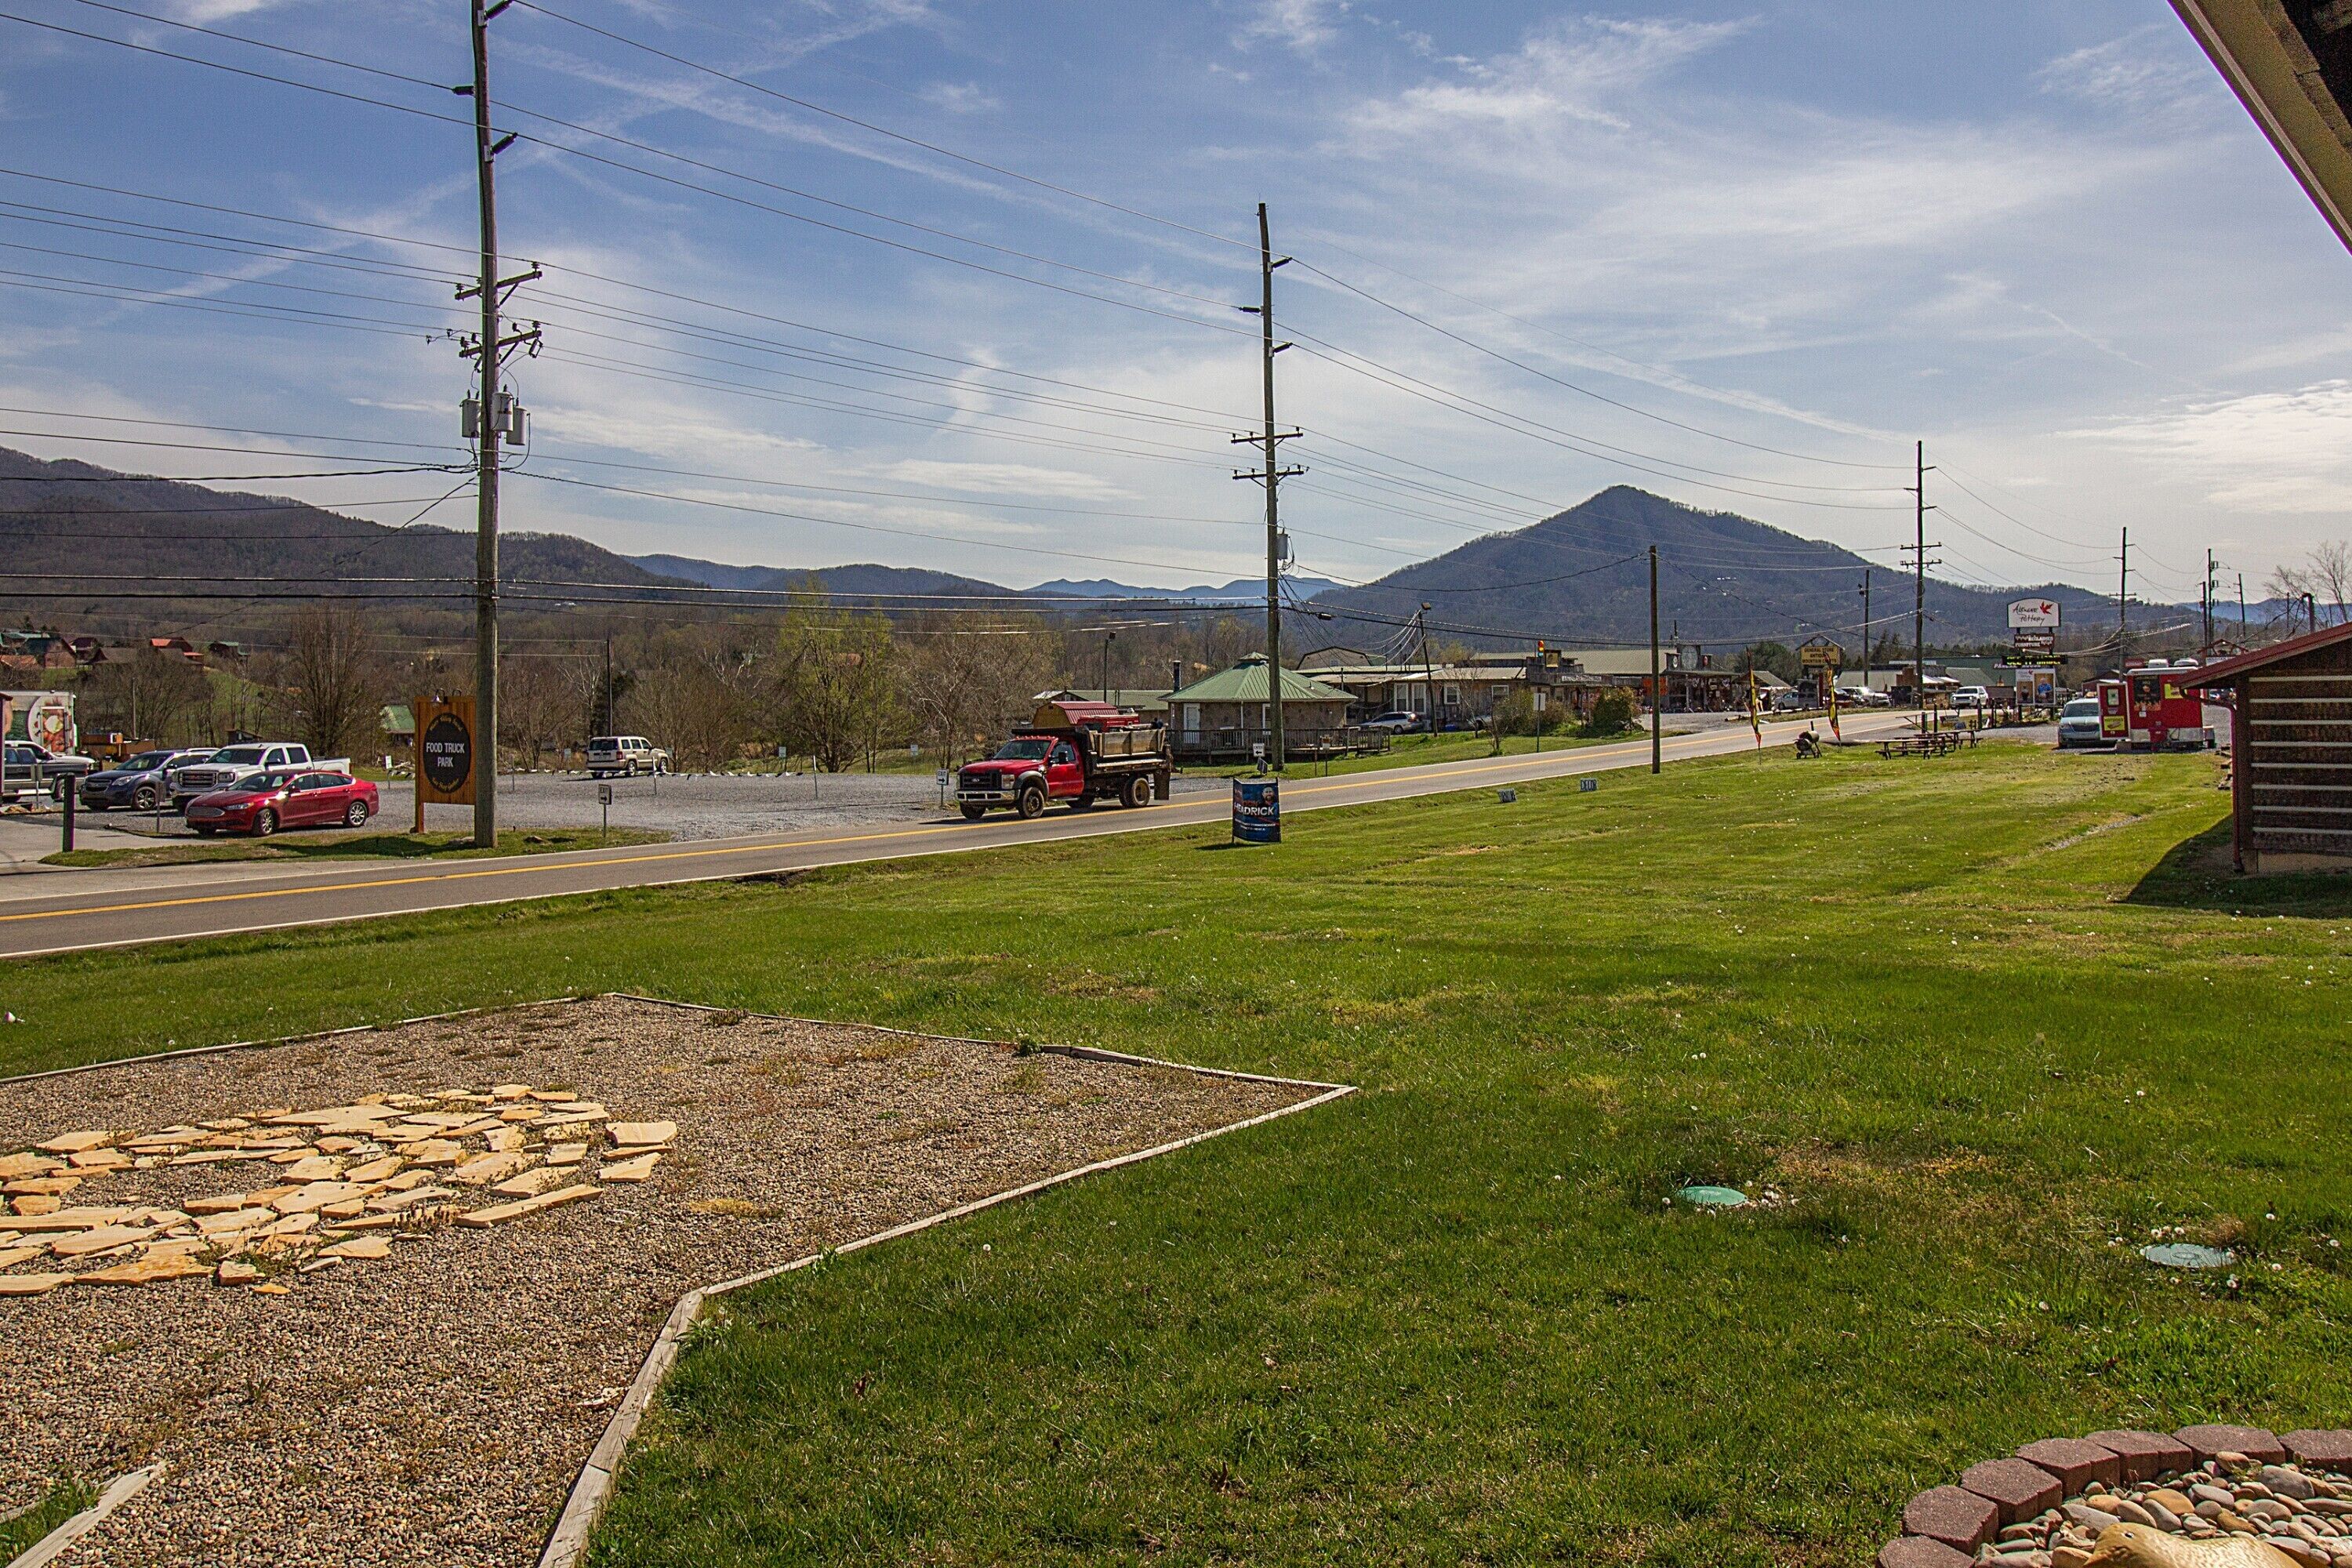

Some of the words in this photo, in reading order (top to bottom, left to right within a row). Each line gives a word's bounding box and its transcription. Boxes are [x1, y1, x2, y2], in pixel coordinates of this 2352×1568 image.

[2020, 615, 2045, 626] Pottery
[426, 742, 443, 753] FOOD
[445, 742, 465, 754] TRUCK
[437, 757, 454, 768] PARK
[1233, 801, 1275, 816] HEADRICK
